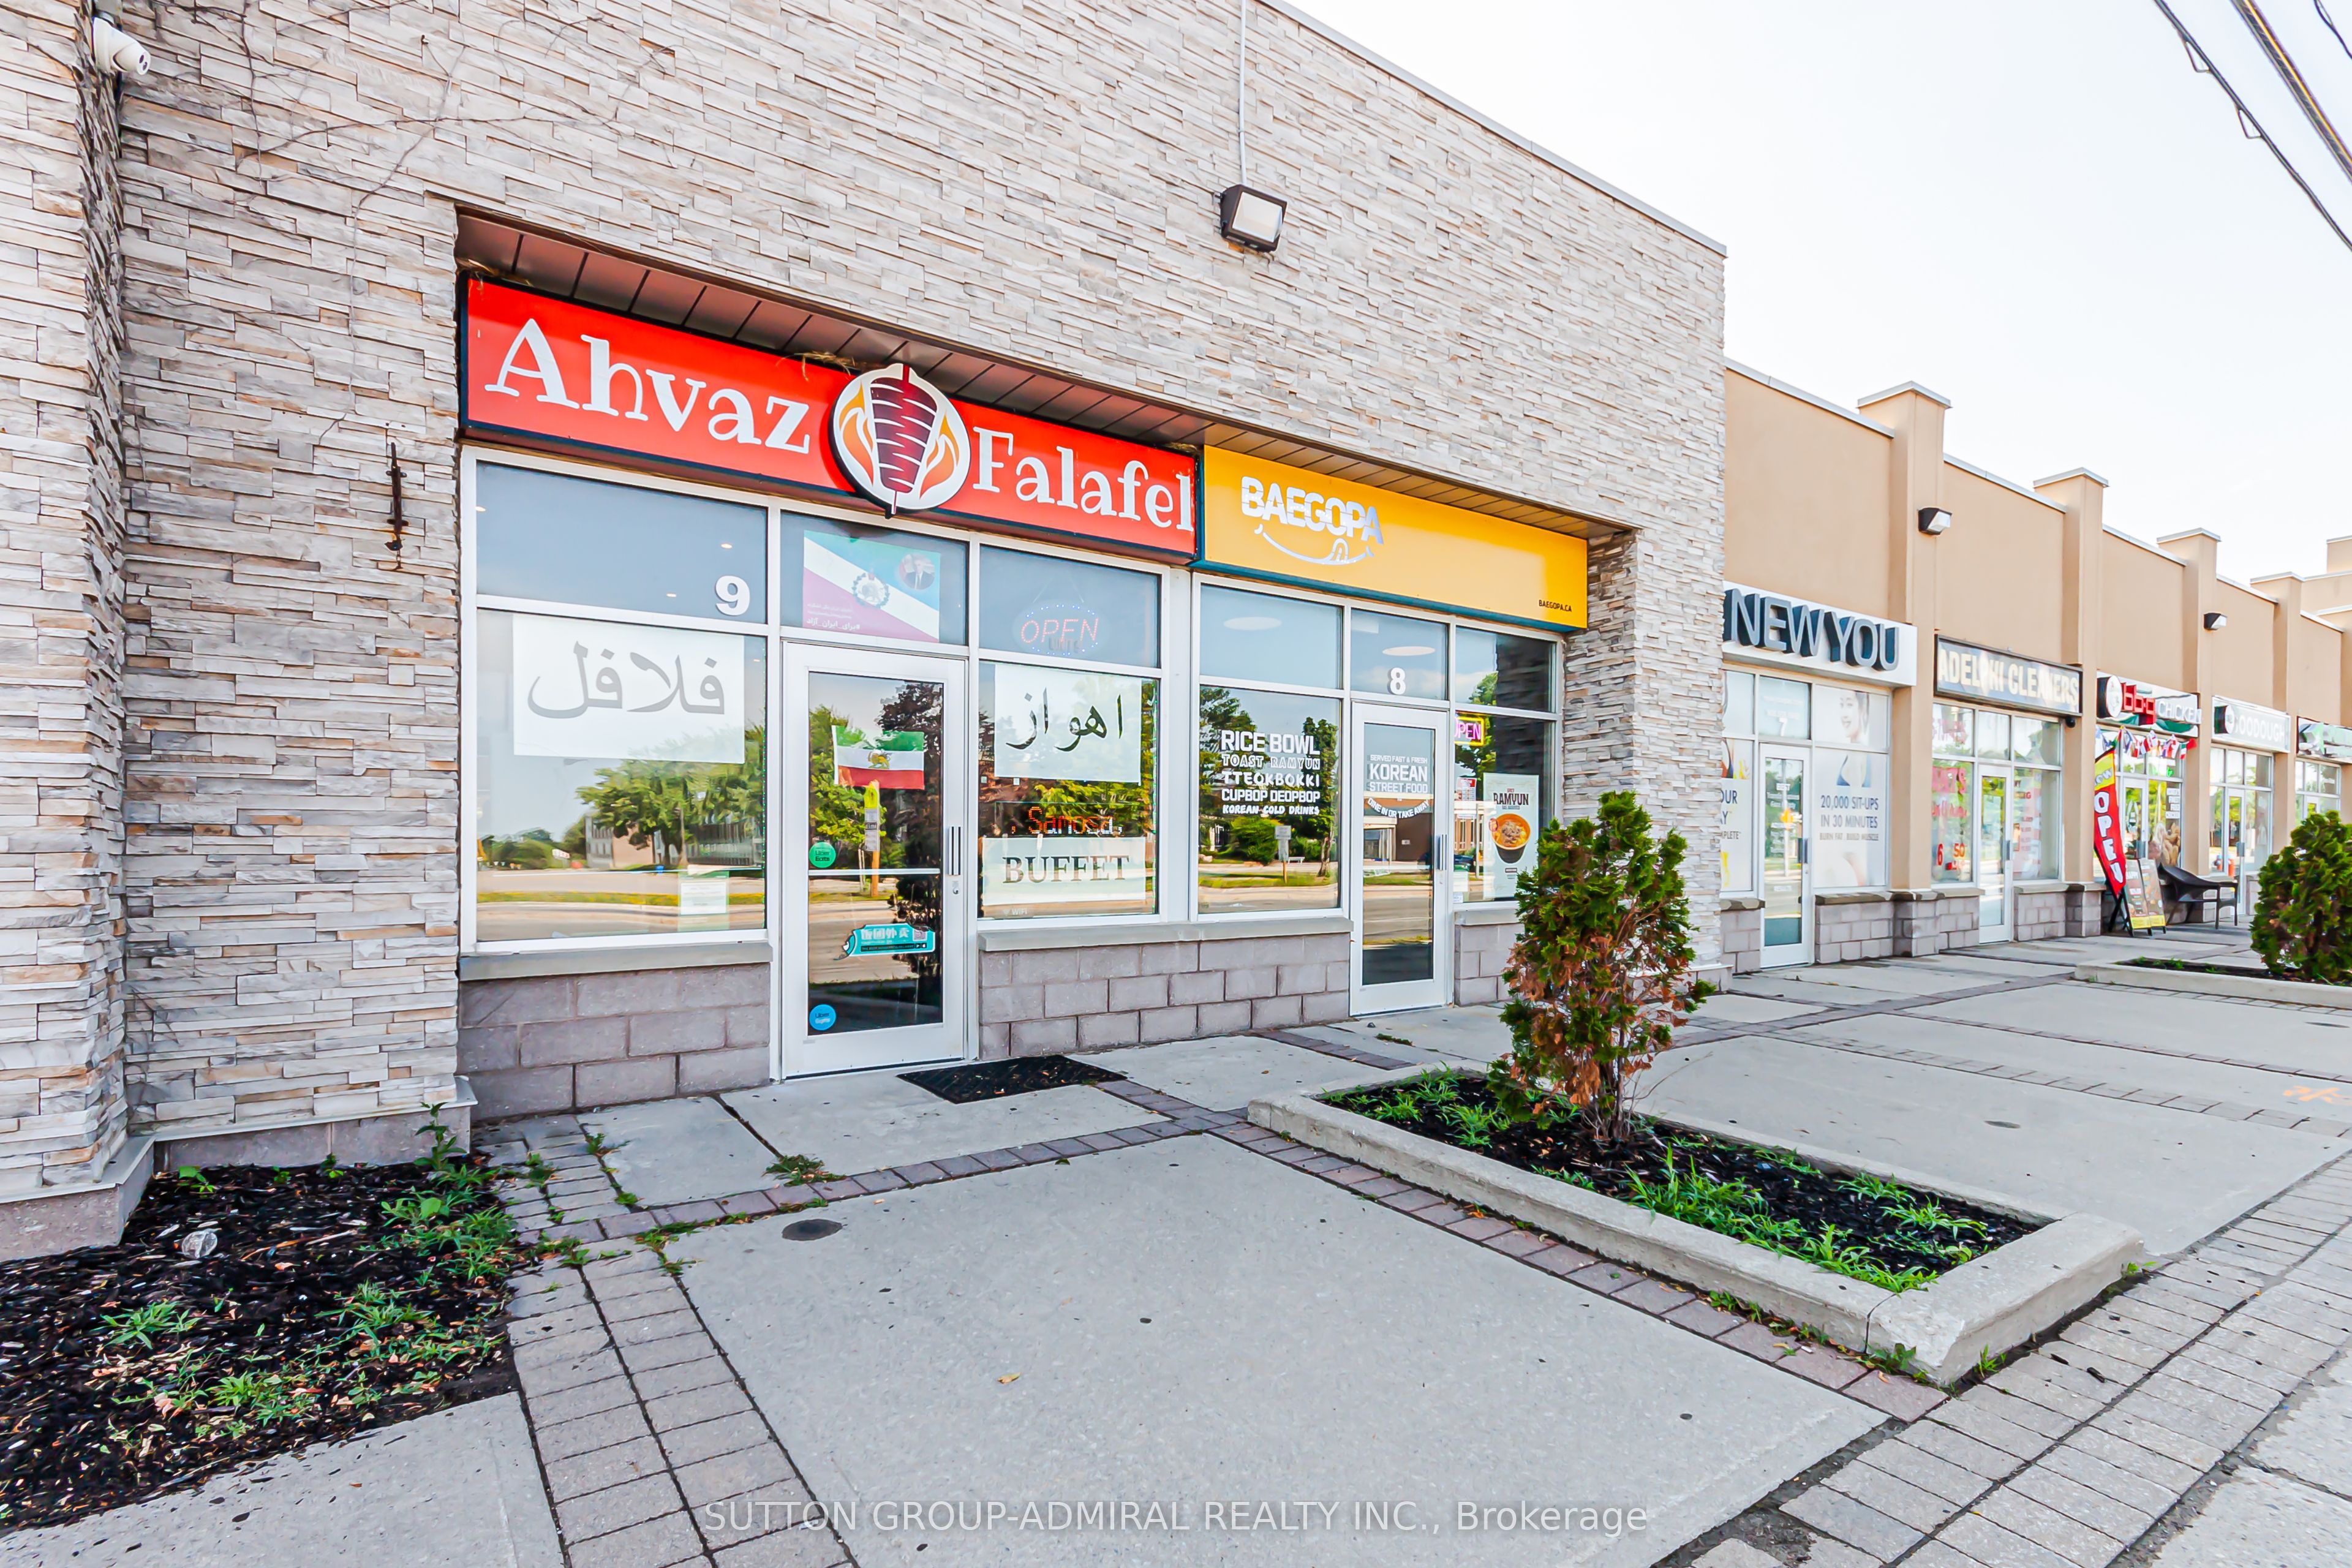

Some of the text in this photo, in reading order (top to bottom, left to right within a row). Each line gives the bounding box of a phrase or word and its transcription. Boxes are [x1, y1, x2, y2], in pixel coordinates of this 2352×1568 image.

[484, 318, 1195, 532] Ahvaz Falafel
[1241, 476, 1384, 545] BAEGOPA
[714, 576, 750, 616] 9
[1538, 599, 1572, 612] BAEGOPA.CA
[1020, 617, 1099, 644] OPEN
[1724, 588, 1900, 671] NEW YOU
[527, 641, 725, 719] فلافل
[1387, 667, 1406, 695] 8
[1006, 687, 1123, 752] اهواز
[2158, 700, 2202, 724] CHICKEN
[1779, 717, 1788, 736] 7
[1221, 729, 1320, 755] RICE BOWL
[1222, 753, 1321, 770] TOAST RAMYUN
[1221, 771, 1320, 787] TTEOKBOKKI
[1370, 763, 1428, 782] KOREAN
[2095, 767, 2113, 785] OW
[1221, 789, 1321, 803] CUPBOP DEOPBOP
[1370, 781, 1428, 794] STREET FOOD
[1367, 797, 1430, 819] DINE IN OR TAKE AWAY
[1493, 793, 1529, 805] RAMYUN
[1821, 796, 1879, 811] 20,000 SIT-UPS
[1223, 804, 1320, 815] KOREAN COLD DRINKS
[1821, 816, 1878, 829] IN 30 MINUTES
[1003, 856, 1129, 883] BUFFET
